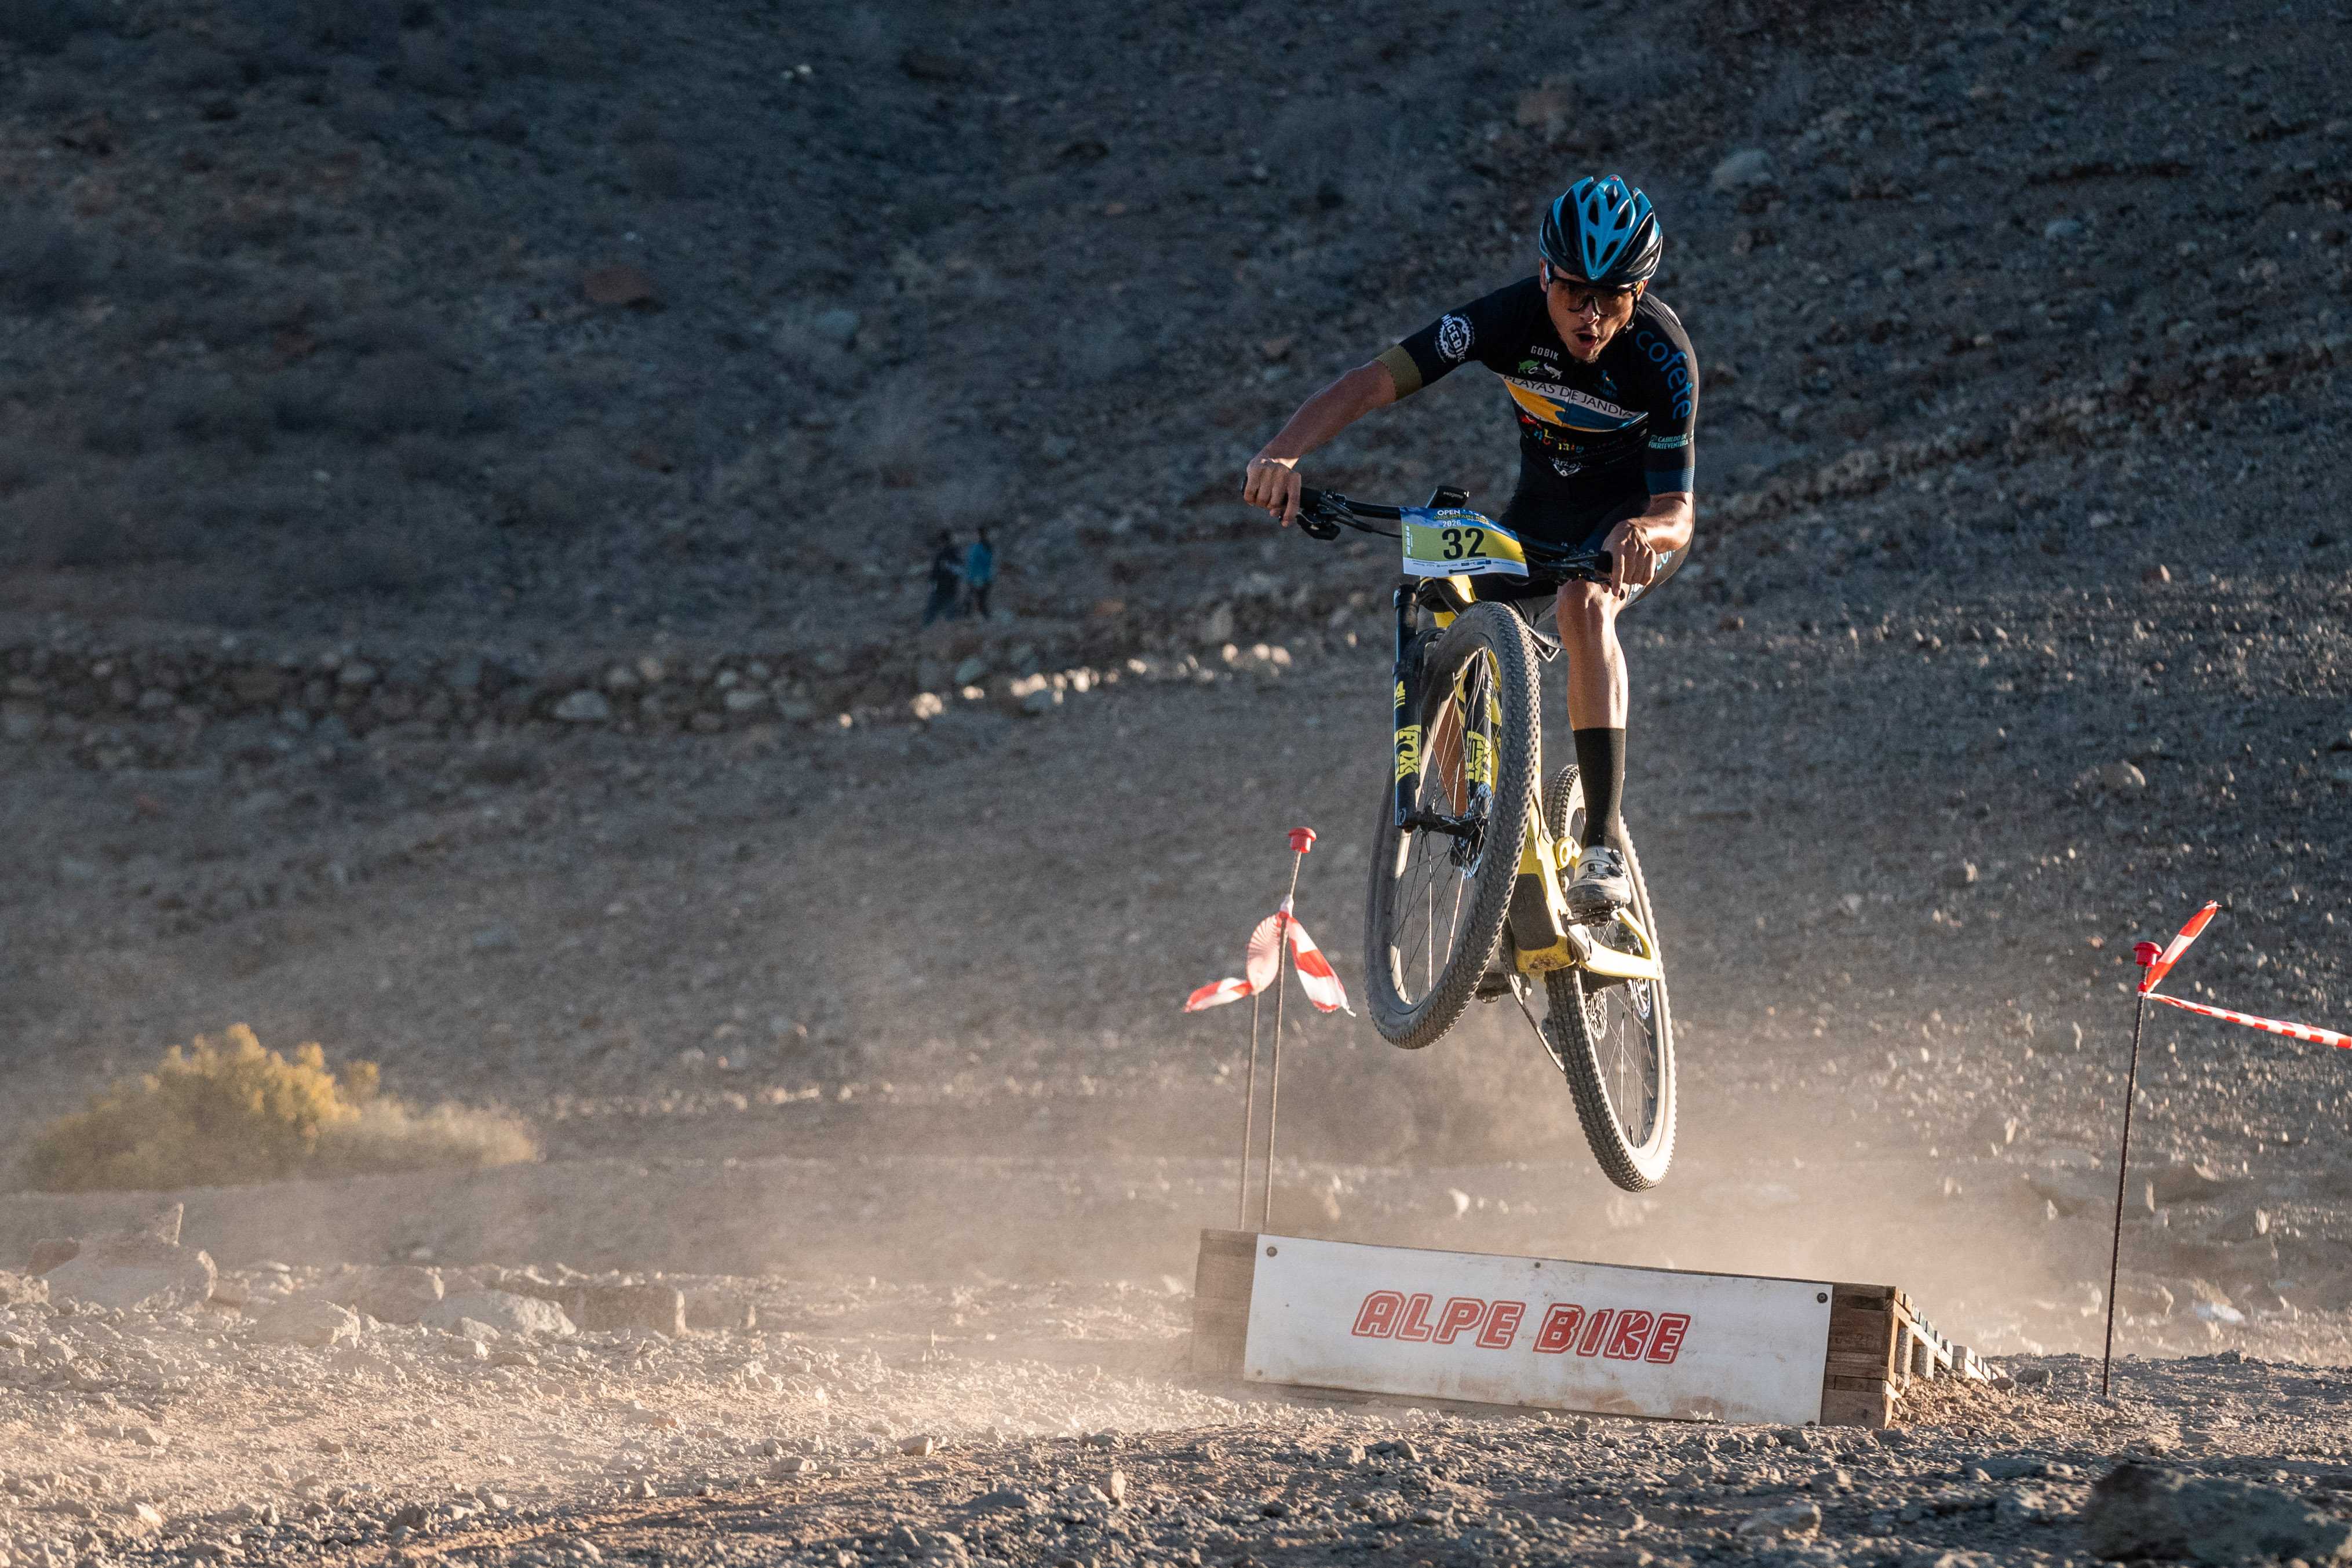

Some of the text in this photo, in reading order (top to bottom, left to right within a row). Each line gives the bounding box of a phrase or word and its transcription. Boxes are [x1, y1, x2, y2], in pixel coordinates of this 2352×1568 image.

[1530, 345, 1559, 361] GOBIK
[1504, 375, 1555, 393] PLAYAS
[1560, 387, 1579, 400] DE
[1636, 331, 1693, 420] cofete
[1442, 527, 1486, 560] 32
[1395, 727, 1421, 778] FOX
[1351, 1290, 1691, 1364] ALPE BIKE
